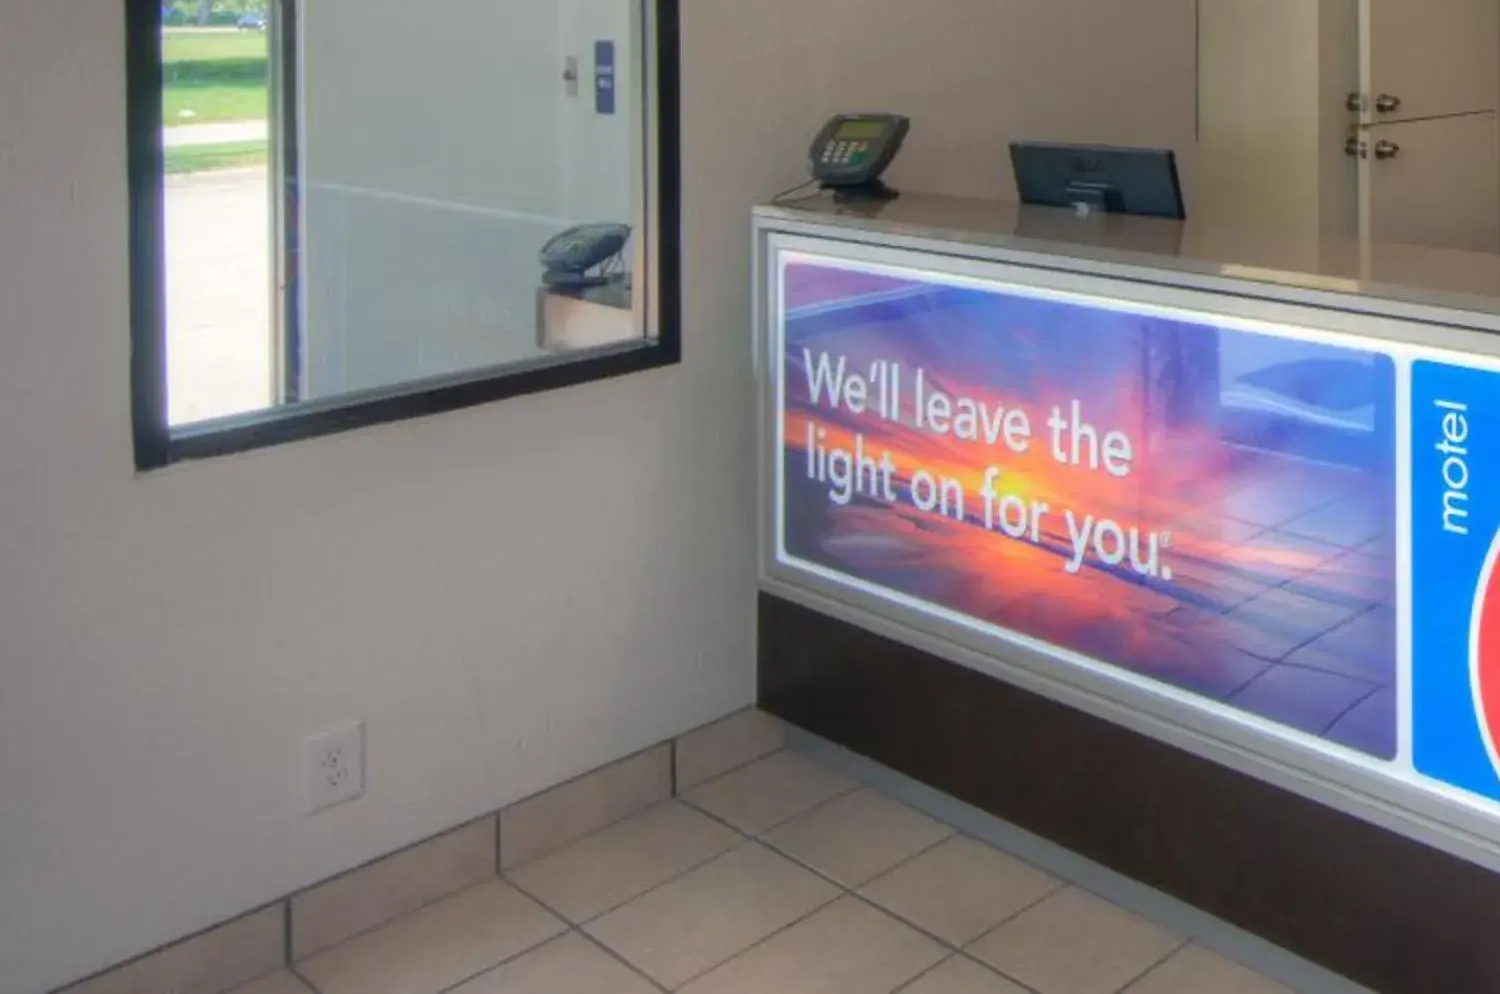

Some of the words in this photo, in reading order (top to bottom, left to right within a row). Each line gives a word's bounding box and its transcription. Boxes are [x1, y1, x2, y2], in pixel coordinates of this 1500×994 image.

[803, 348, 899, 421] We'll
[915, 368, 1031, 451] leave
[1047, 400, 1133, 476] the
[1434, 399, 1469, 536] motel
[806, 422, 898, 505] light
[911, 469, 965, 520] on
[979, 466, 1048, 543] for
